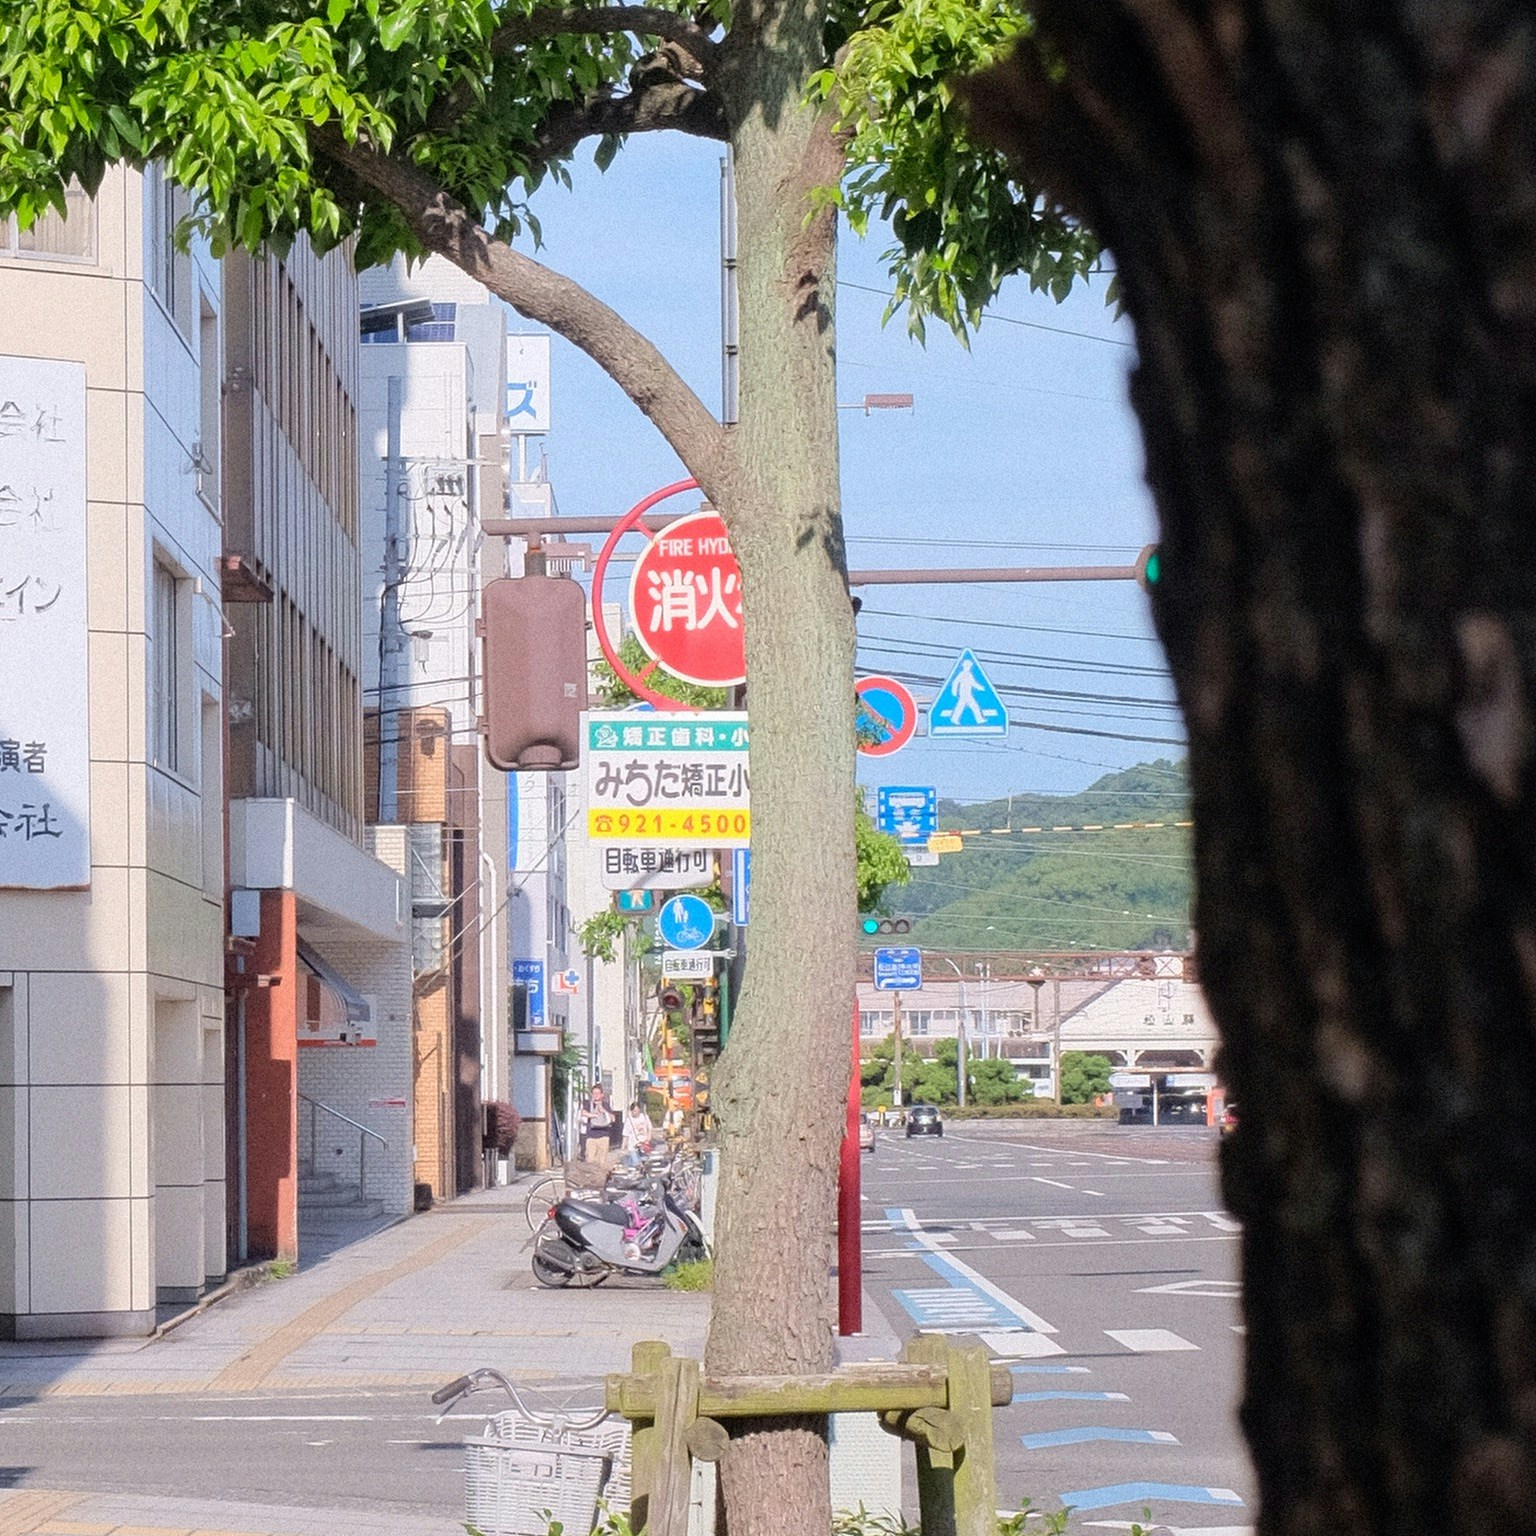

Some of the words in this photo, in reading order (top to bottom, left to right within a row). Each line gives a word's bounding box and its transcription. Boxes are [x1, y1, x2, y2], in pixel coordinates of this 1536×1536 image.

[659, 539, 692, 556] FIRE
[698, 537, 733, 555] HYD
[647, 567, 743, 632] 消火
